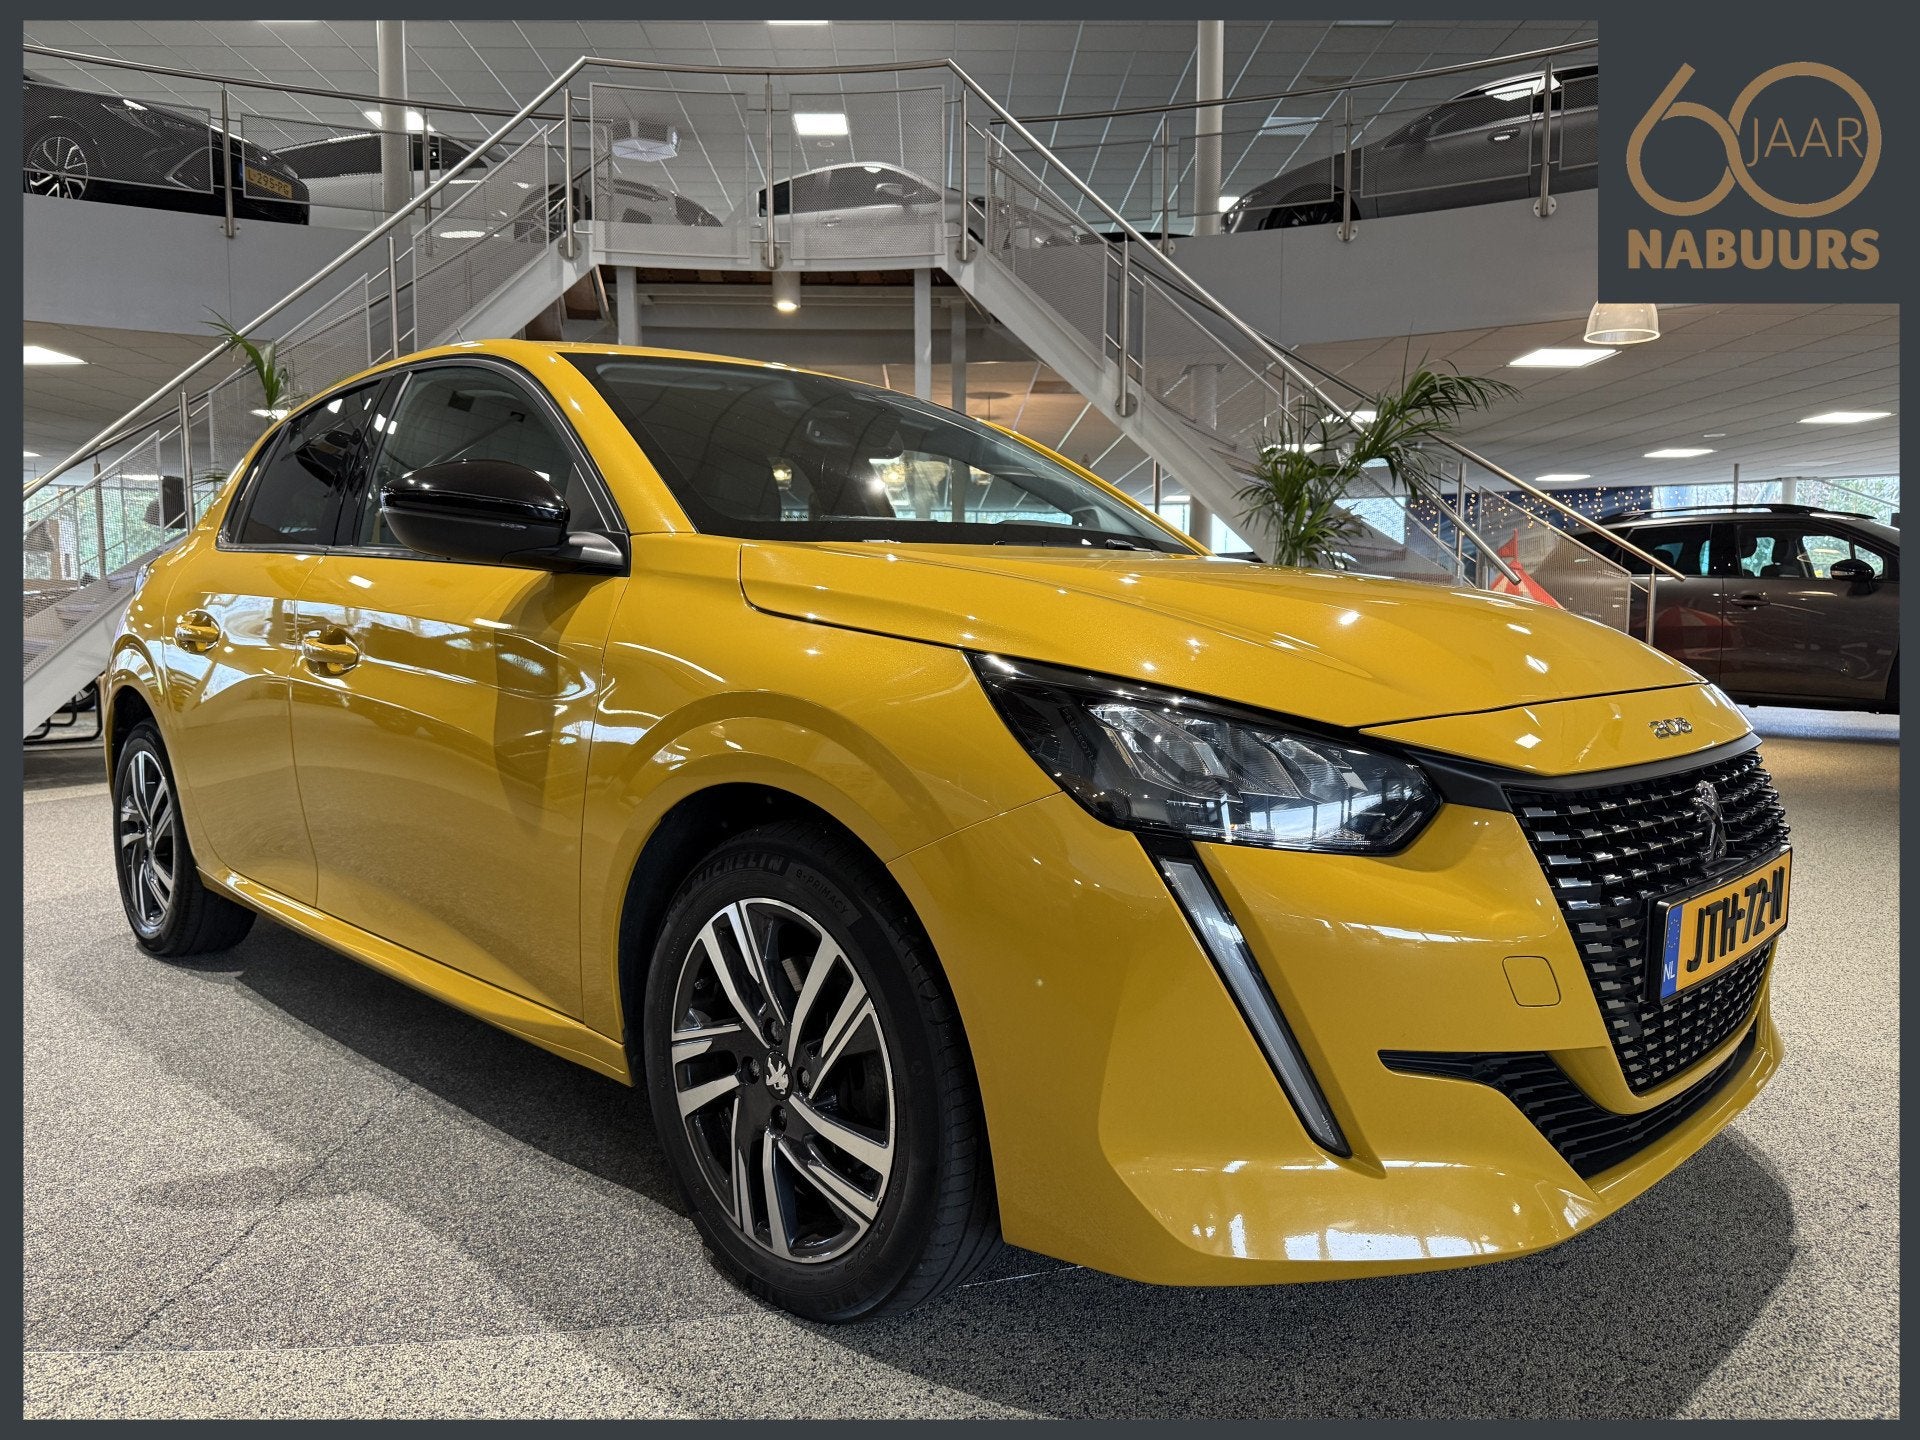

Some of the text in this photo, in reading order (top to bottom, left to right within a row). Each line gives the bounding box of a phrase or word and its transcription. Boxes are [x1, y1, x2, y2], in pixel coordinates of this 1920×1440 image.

[1648, 717, 1693, 739] 208
[1686, 866, 1786, 973] JTH-72-N
[1662, 960, 1676, 983] NL
